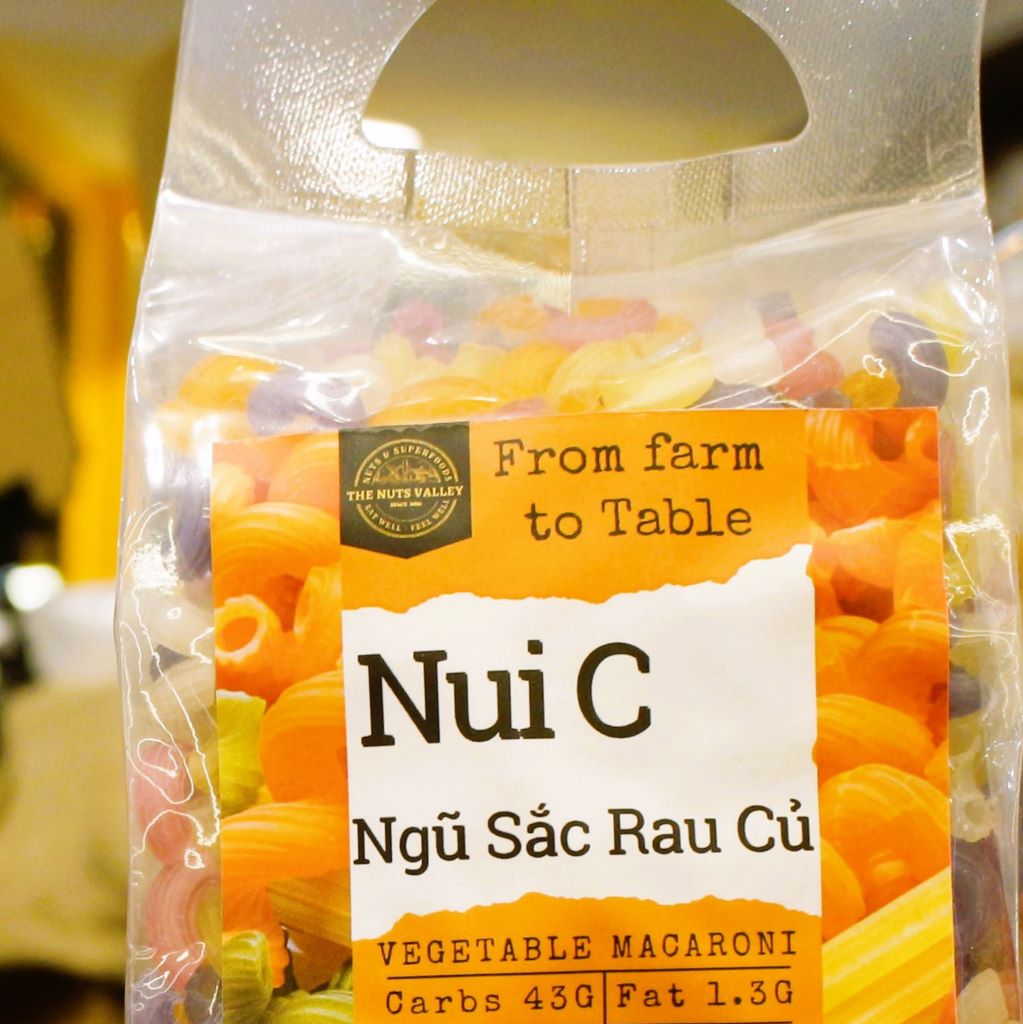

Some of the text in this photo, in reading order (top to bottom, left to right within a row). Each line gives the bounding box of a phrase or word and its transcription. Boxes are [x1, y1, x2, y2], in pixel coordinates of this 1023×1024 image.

[393, 445, 453, 482] SUPERFOODS
[494, 432, 764, 477] From farm
[346, 485, 464, 501] THE NUTS VALLEY
[524, 498, 752, 541] to Table
[357, 639, 652, 748] Nui C
[352, 798, 814, 876] Ngũ Sắc Rau Củ
[377, 930, 796, 966] VEGETABLE MACARONI
[386, 984, 594, 1014] Carbs 43G
[617, 979, 793, 1008] Fat 1.3G
